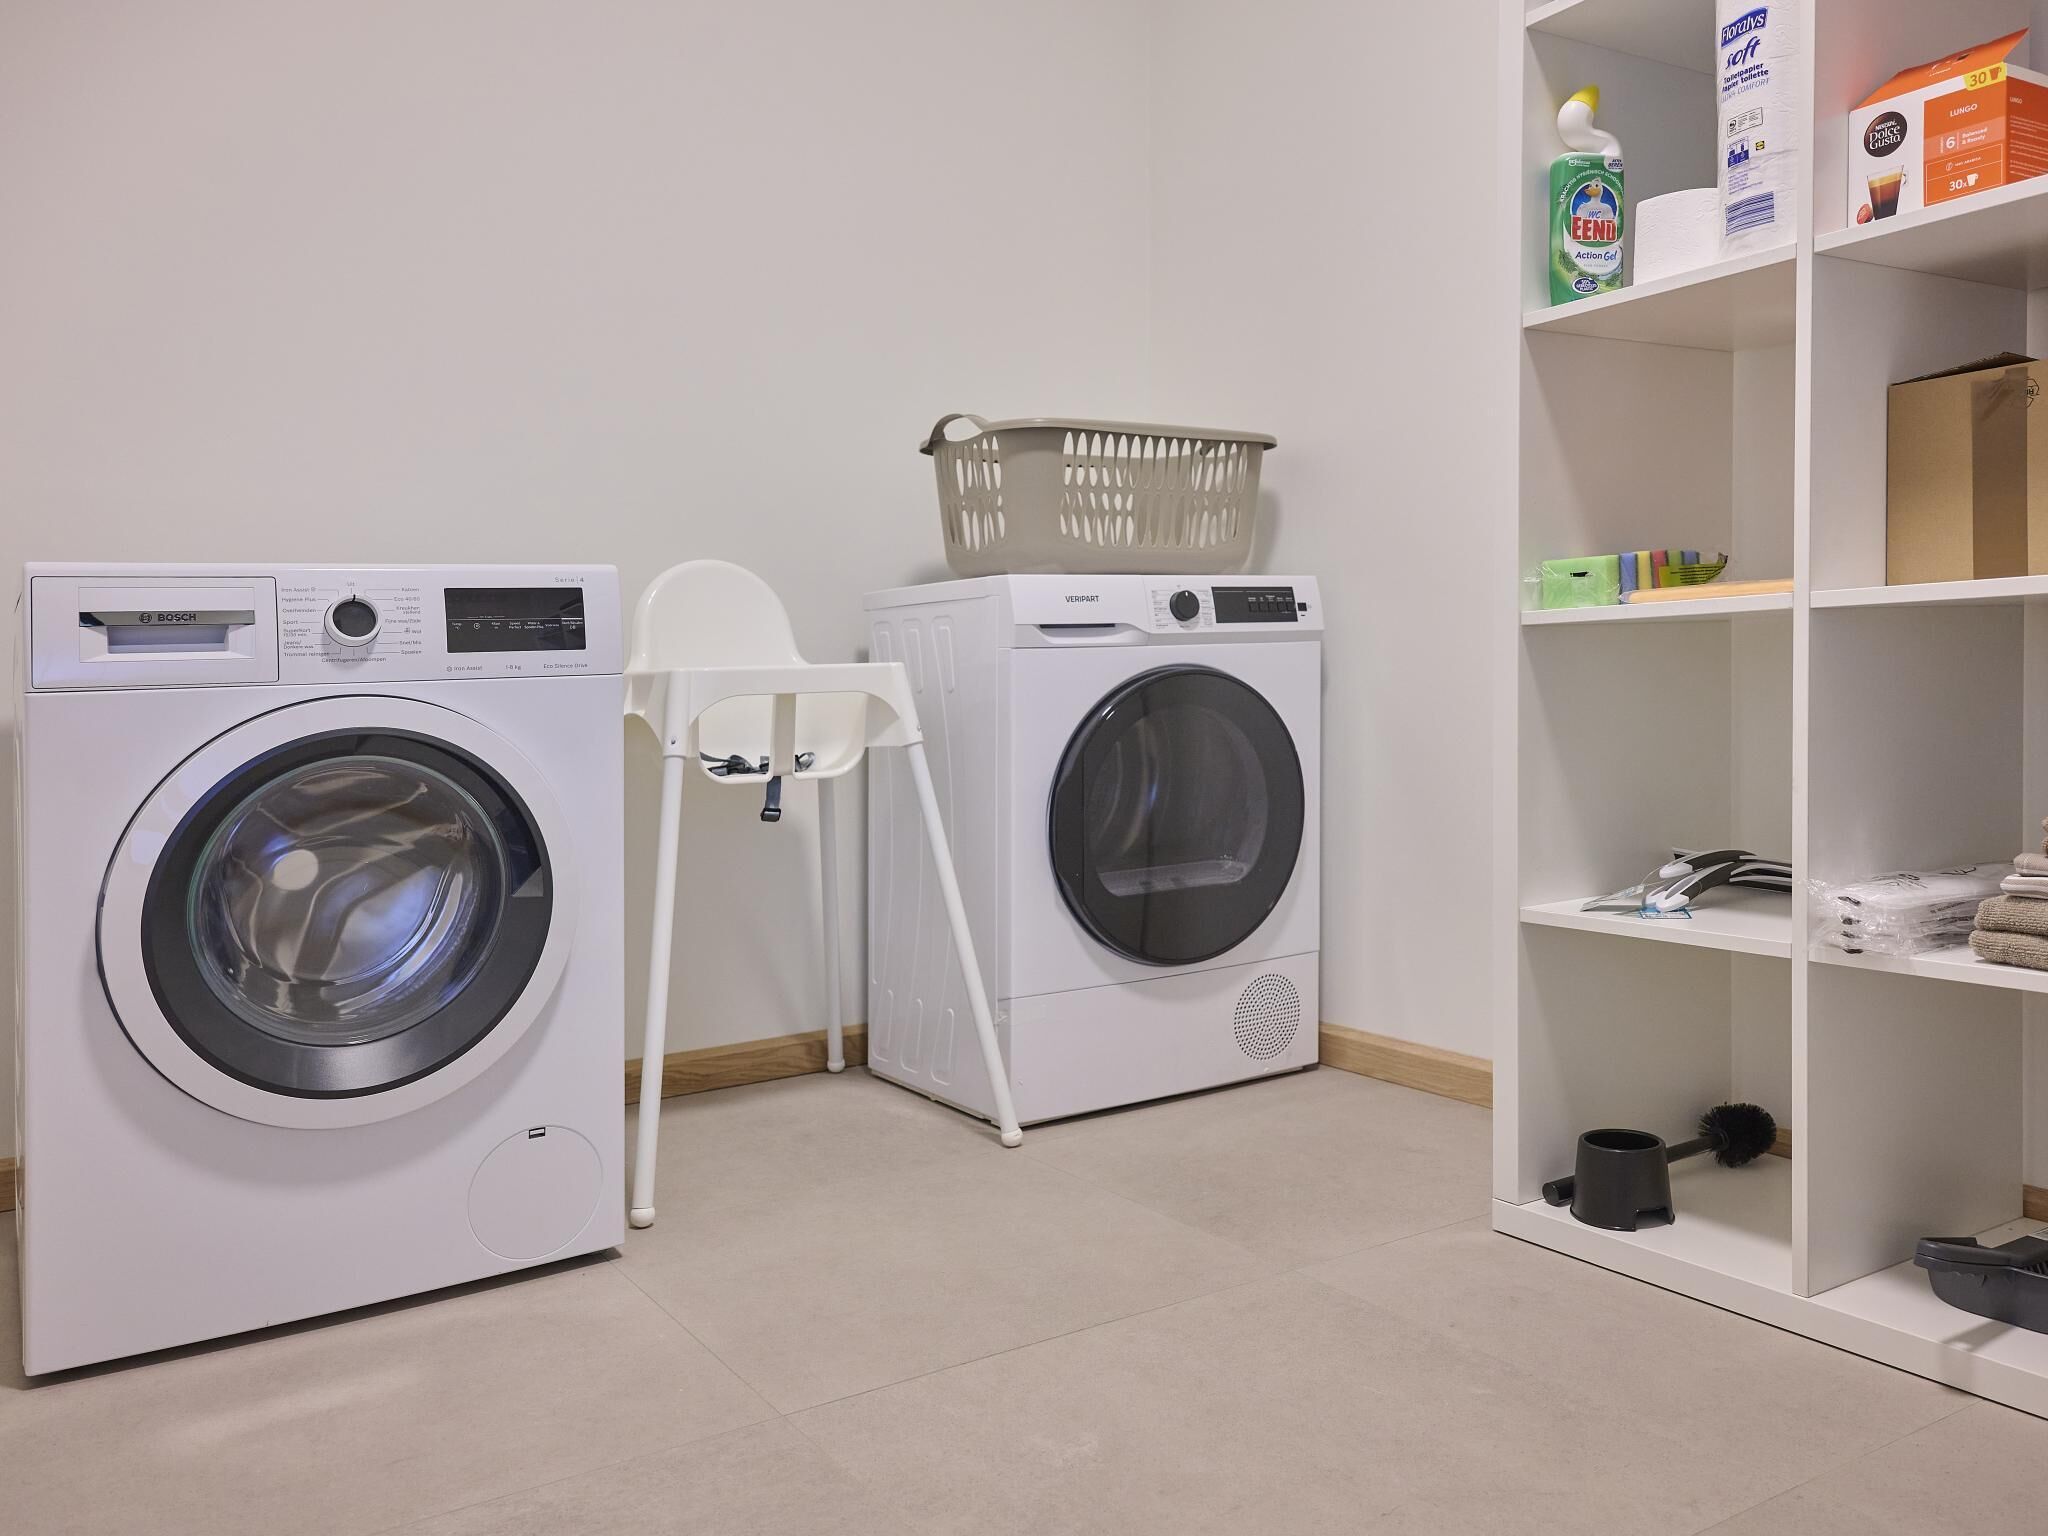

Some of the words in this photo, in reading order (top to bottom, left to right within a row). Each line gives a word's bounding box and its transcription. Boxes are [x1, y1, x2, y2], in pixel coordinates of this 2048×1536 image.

[1722, 13, 1766, 42] Floralys
[1725, 36, 1760, 70] soft
[1741, 69, 1769, 83] toilette
[1970, 71, 1987, 87] 30
[1737, 78, 1770, 95] COMFORT
[1950, 103, 1978, 117] LUNGO
[1869, 125, 1901, 142] Dolce
[1945, 136, 1955, 149] 6
[1588, 210, 1602, 218] WC
[1572, 215, 1617, 241] EEND
[1575, 251, 1602, 260] Action
[1603, 250, 1618, 261] Gel
[1065, 594, 1100, 603] VERIPART
[157, 613, 197, 622] BOSCH
